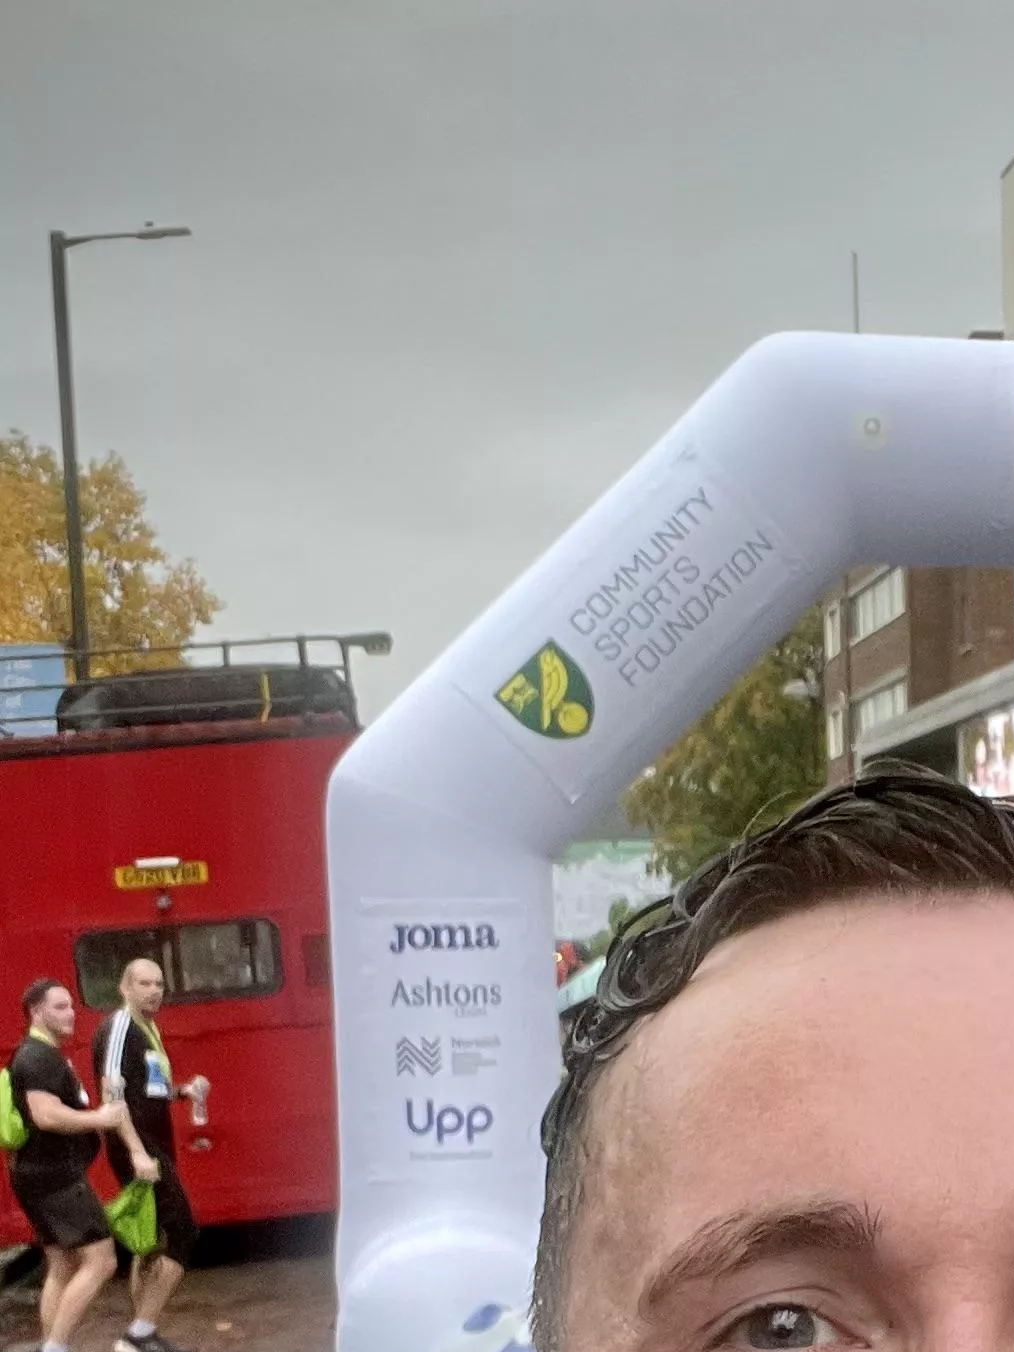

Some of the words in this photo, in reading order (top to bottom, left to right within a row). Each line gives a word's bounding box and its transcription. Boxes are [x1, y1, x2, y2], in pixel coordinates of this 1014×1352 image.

[569, 486, 714, 637] COMMUNITY
[594, 555, 701, 662] SPORTS
[617, 529, 774, 688] FOUNDATION
[390, 976, 502, 1008] Ashtons
[405, 1098, 493, 1146] Upp
